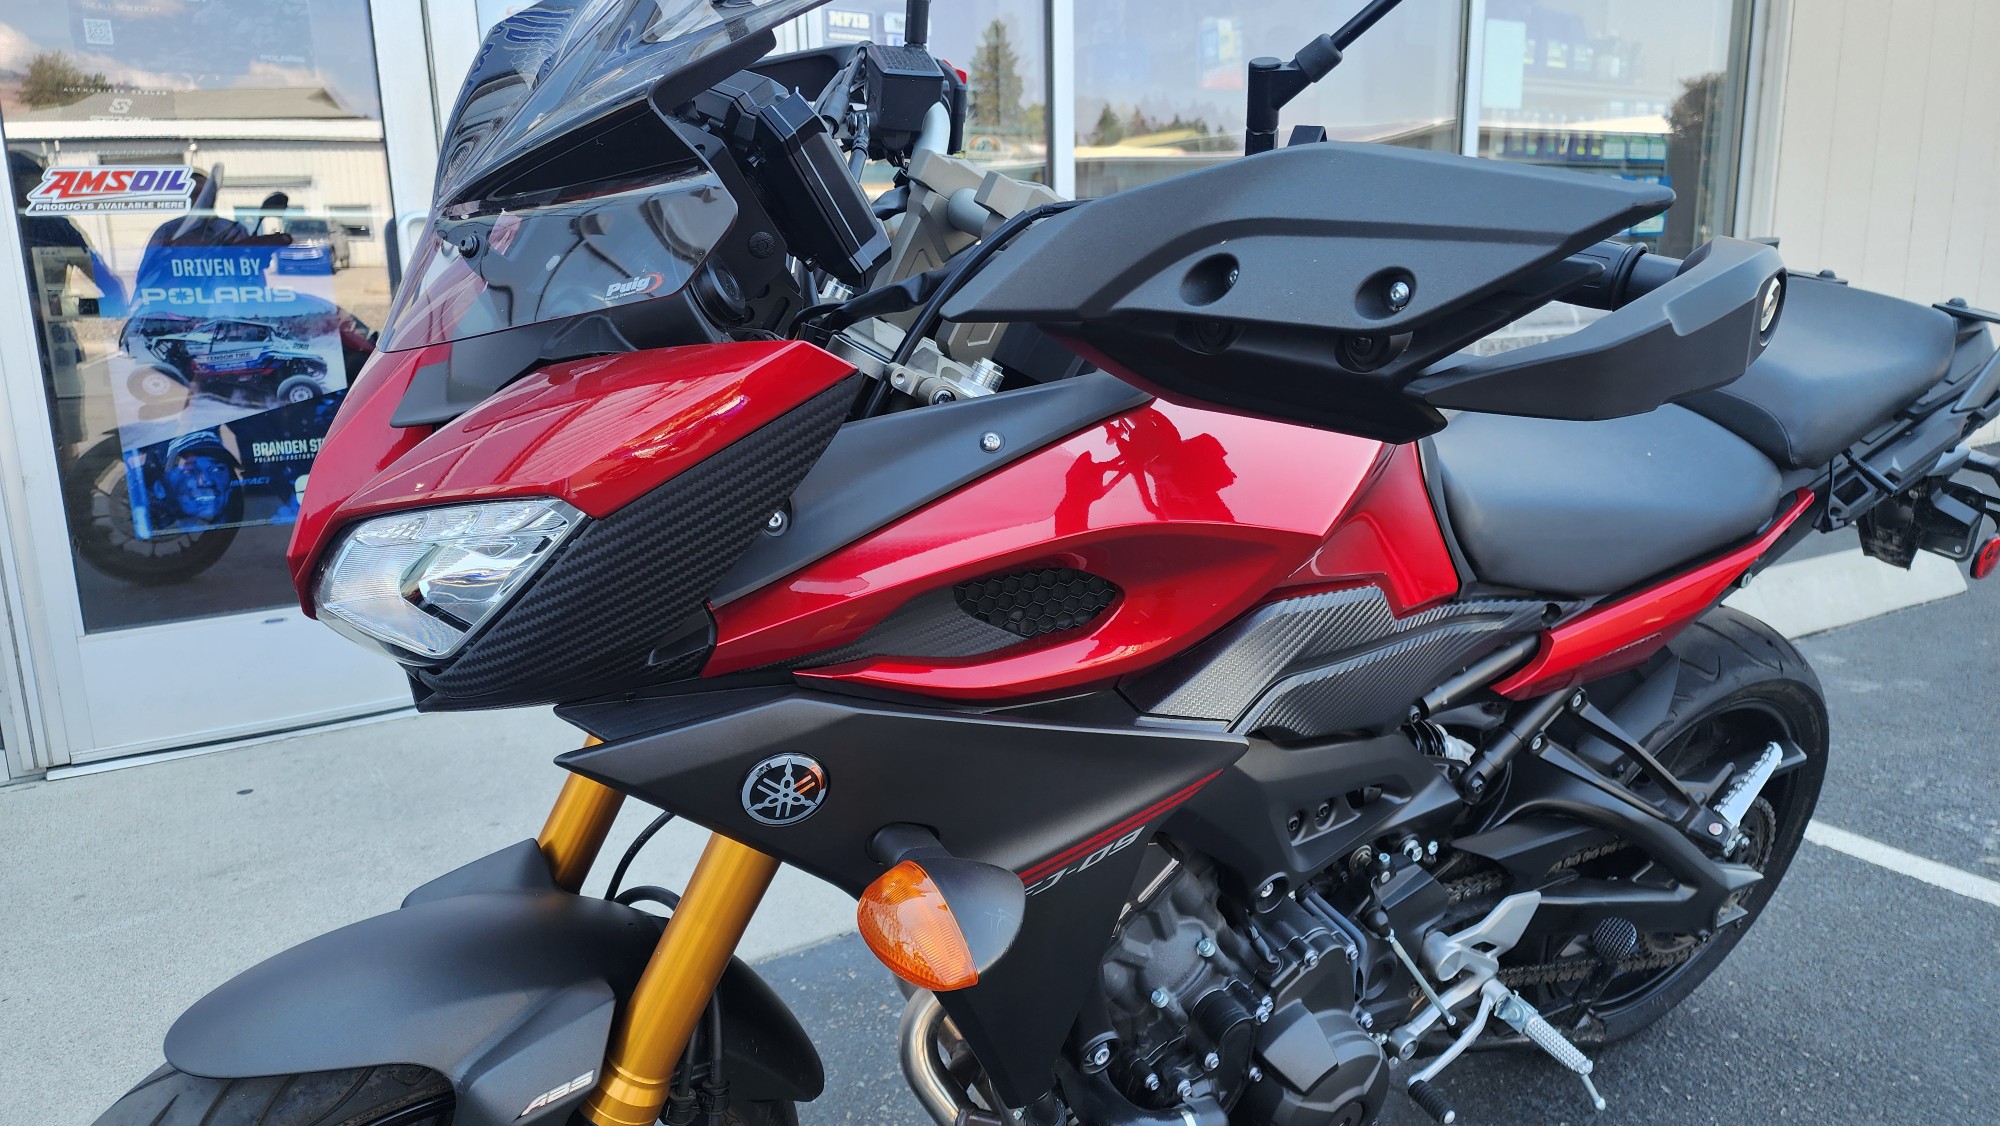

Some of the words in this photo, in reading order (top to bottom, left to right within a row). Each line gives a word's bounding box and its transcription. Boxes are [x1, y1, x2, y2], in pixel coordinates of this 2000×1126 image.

[63, 86, 125, 95] AUTHORIZED
[40, 170, 188, 199] AMSOIL
[35, 202, 95, 212] PRODUCTS
[97, 201, 155, 210] AVAILABLE
[156, 201, 185, 209] HERE
[171, 258, 236, 277] DRIVEN
[239, 258, 261, 276] BY
[140, 286, 297, 306] POLARIS
[605, 276, 651, 297] Puig
[252, 439, 308, 458] BRANDEN
[520, 1069, 595, 1117] ABS
